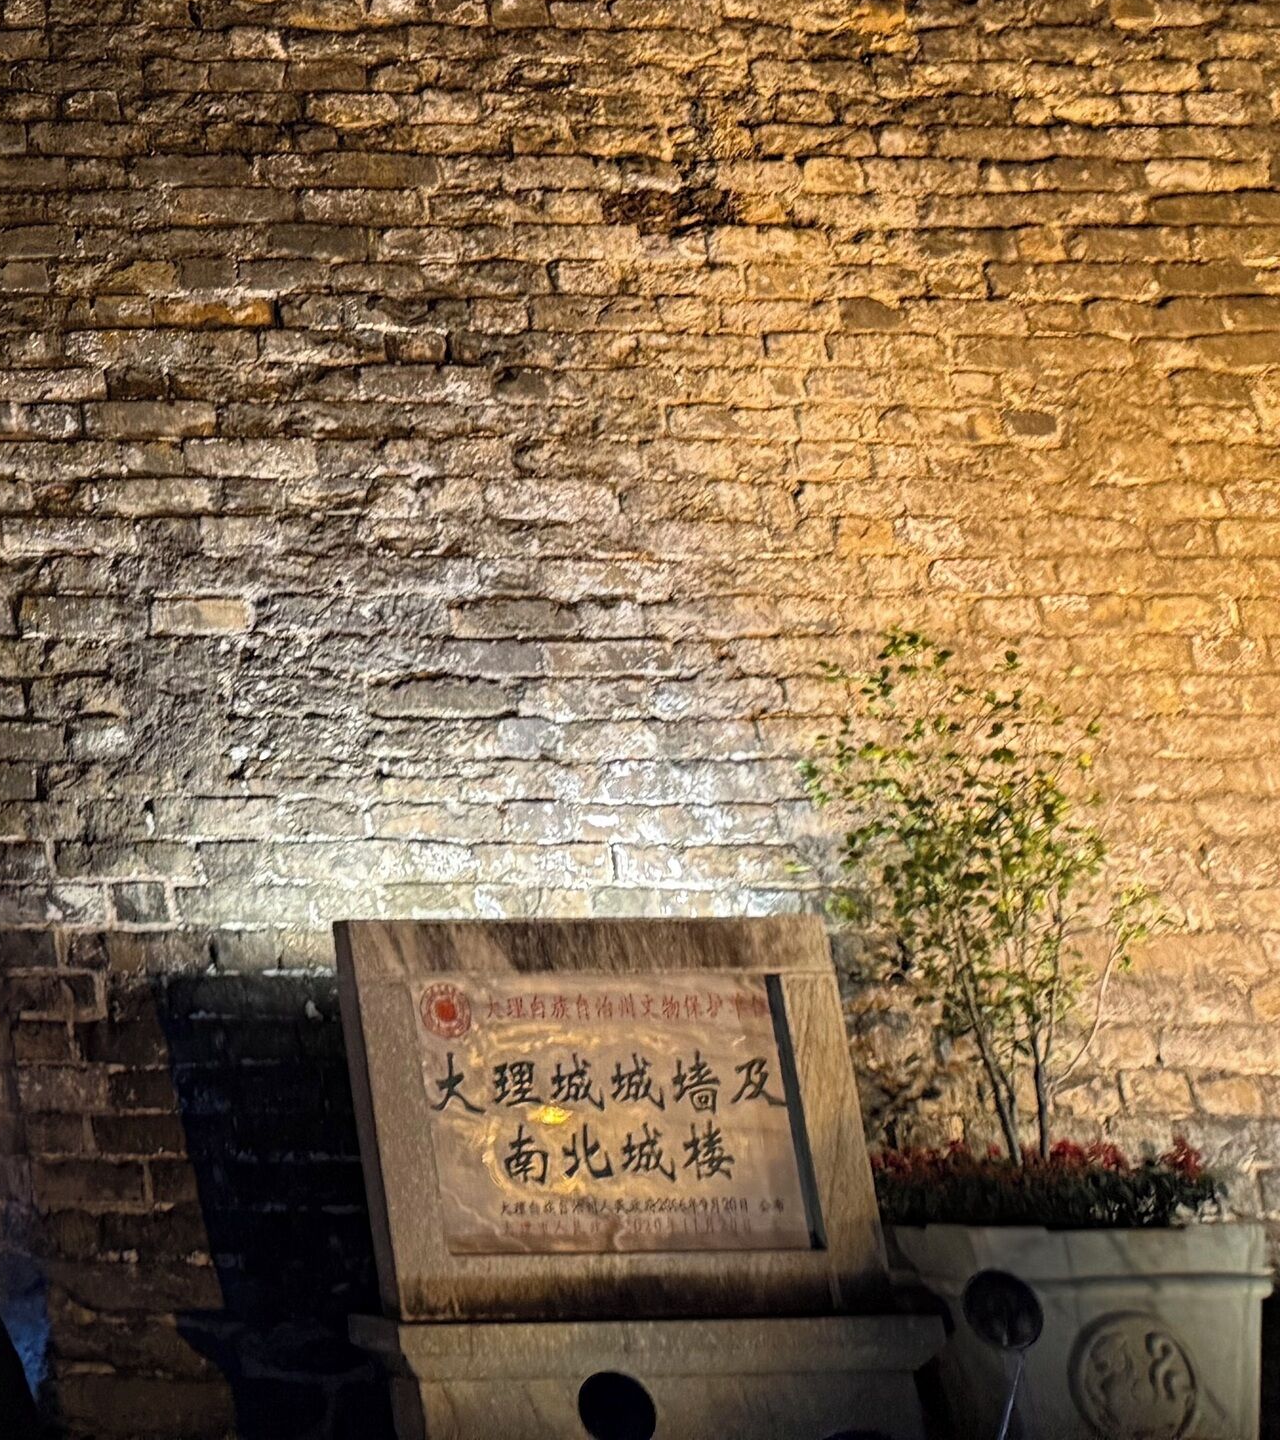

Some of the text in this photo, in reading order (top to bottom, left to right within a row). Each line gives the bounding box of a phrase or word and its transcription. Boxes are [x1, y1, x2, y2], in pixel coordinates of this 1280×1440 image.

[430, 1049, 788, 1114] 大理城城墙及
[502, 1122, 736, 1184] 南北城楼
